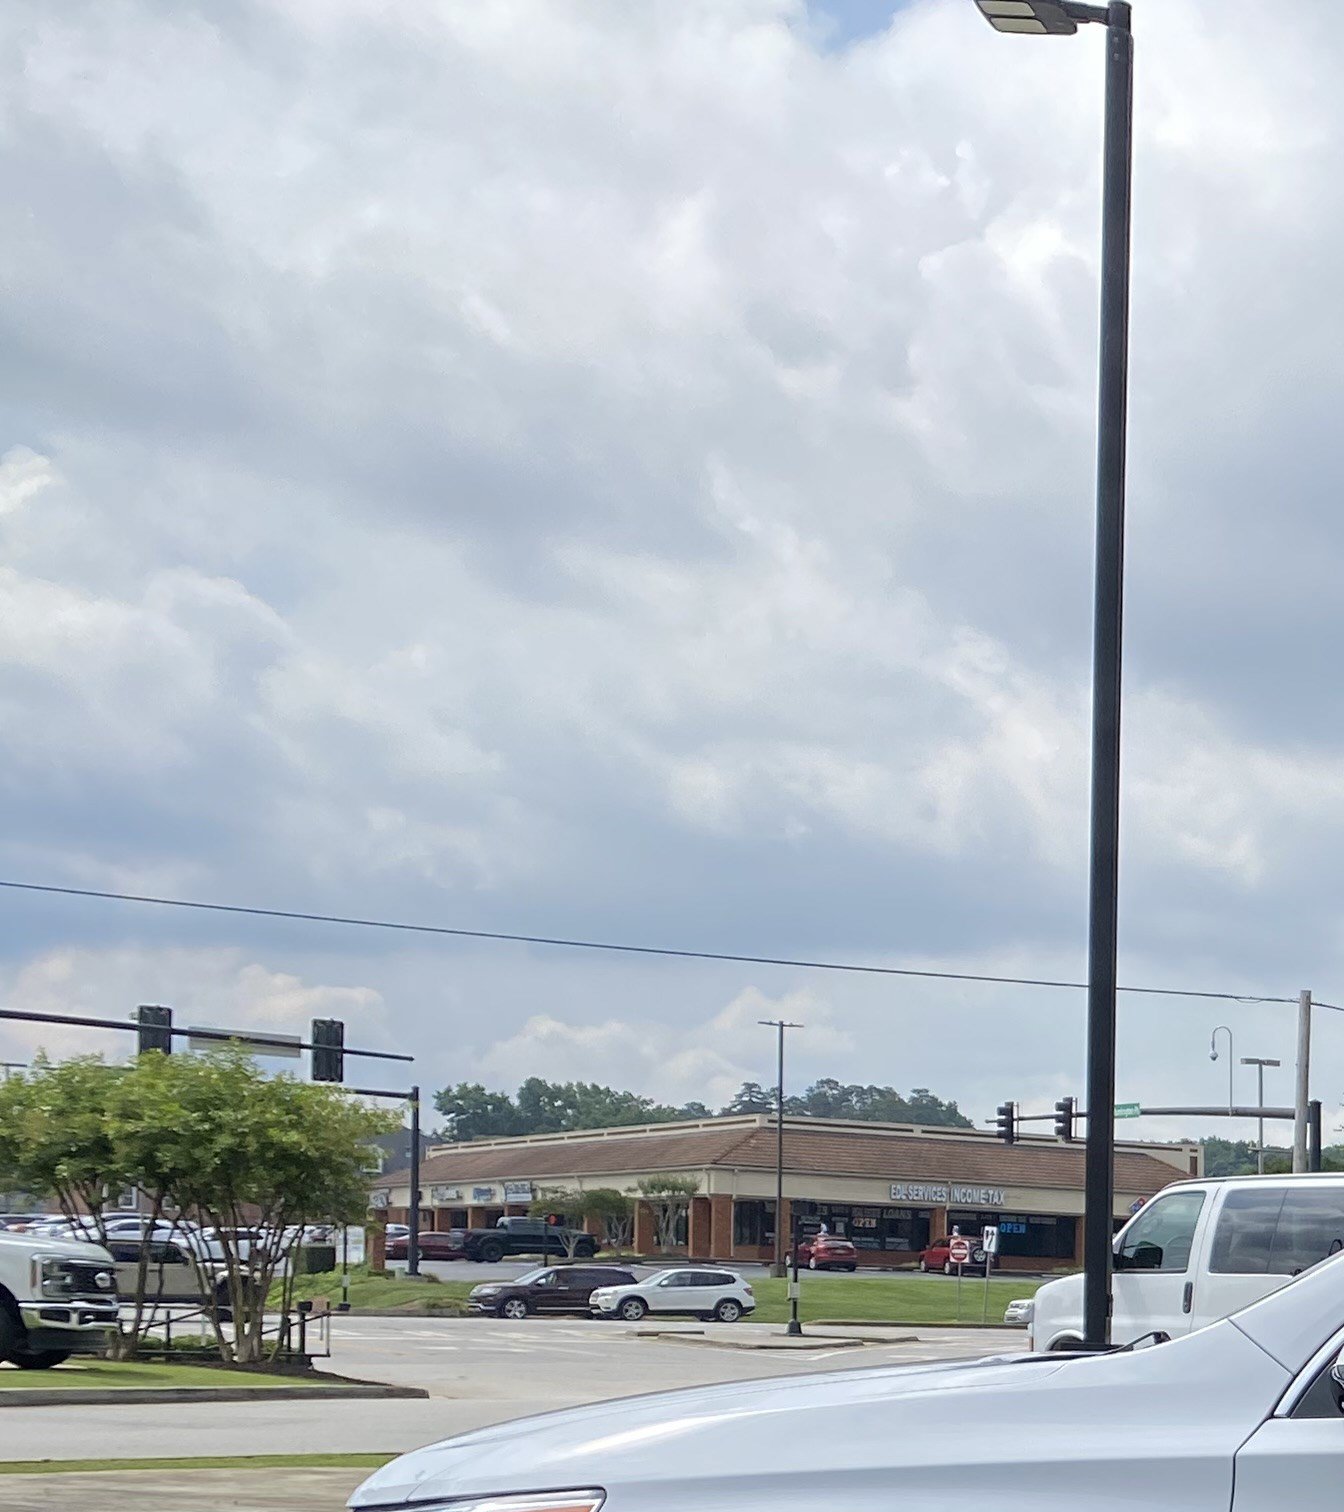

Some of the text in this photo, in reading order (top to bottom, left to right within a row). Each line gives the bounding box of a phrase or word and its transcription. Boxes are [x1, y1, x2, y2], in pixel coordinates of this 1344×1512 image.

[950, 1187, 988, 1204] INCOME
[988, 1189, 1006, 1206] TAX
[1000, 1223, 1026, 1234] OPEN
